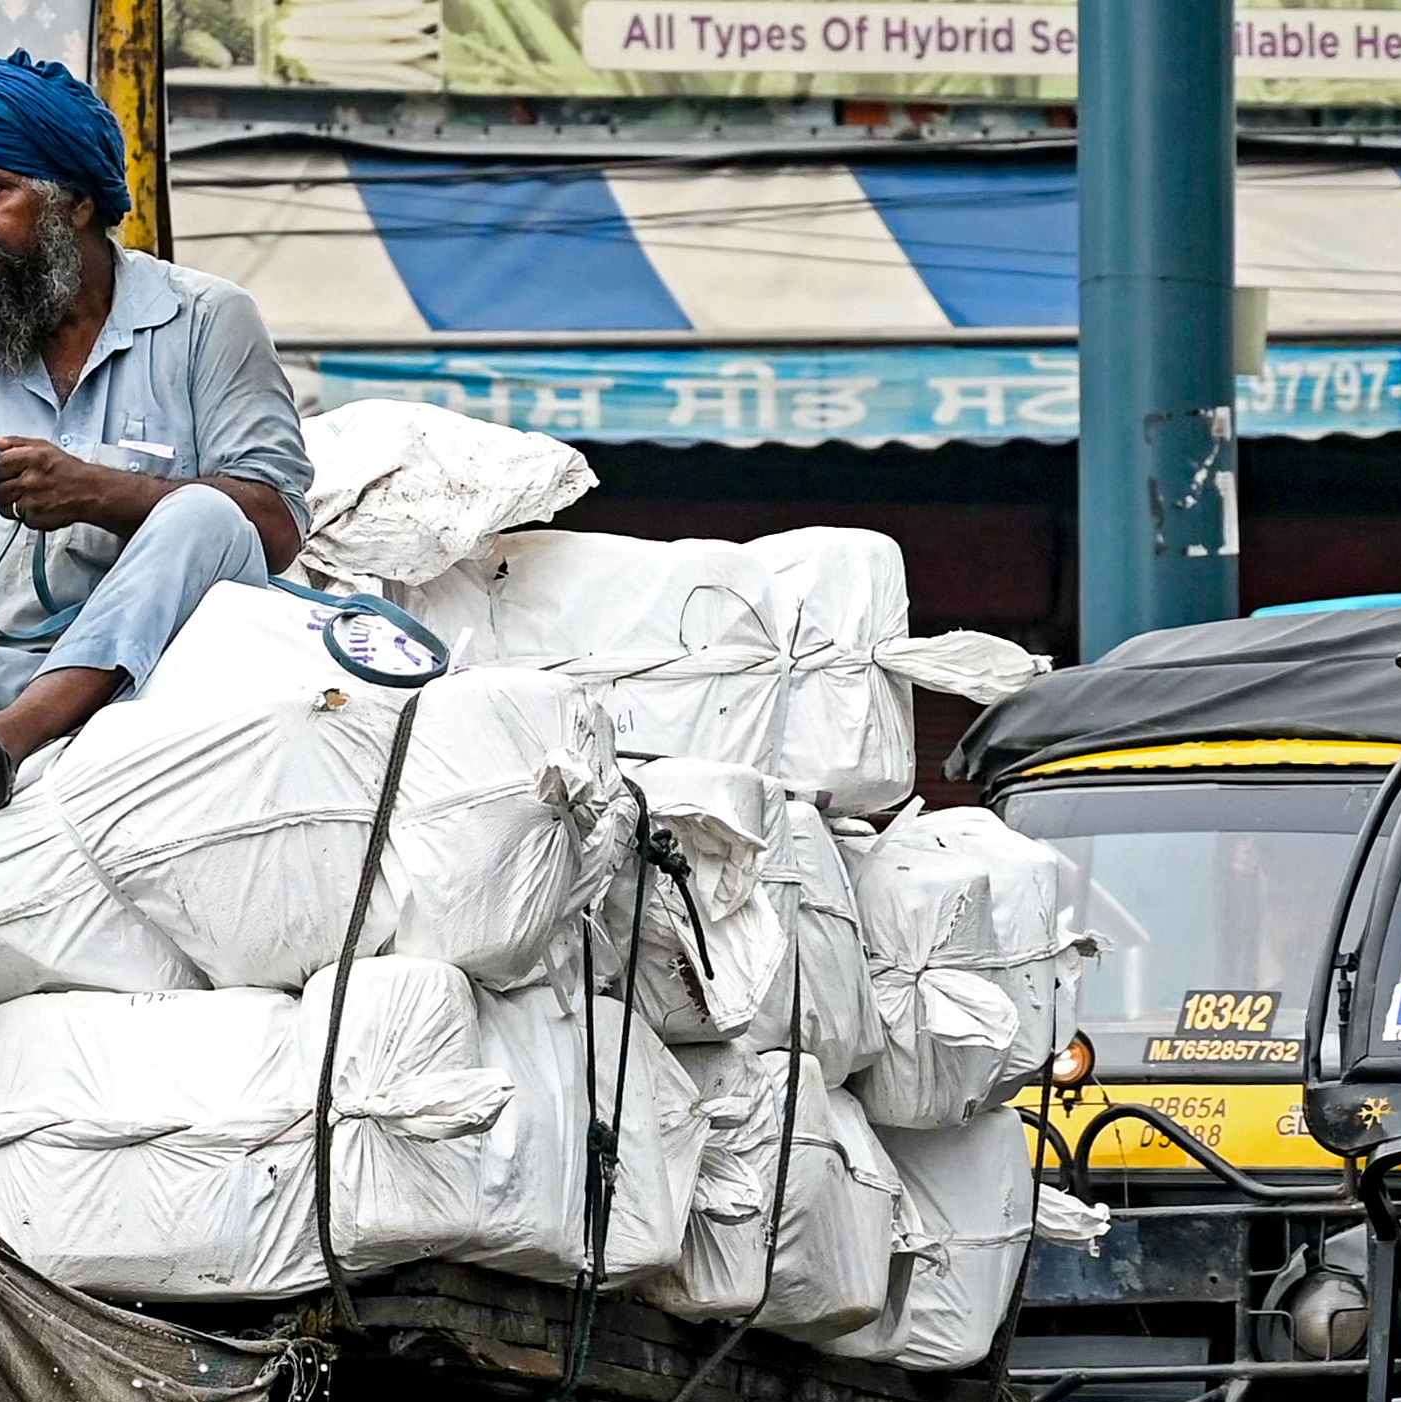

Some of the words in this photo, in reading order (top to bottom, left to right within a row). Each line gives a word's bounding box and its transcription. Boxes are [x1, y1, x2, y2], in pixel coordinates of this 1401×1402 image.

[622, 14, 674, 51] All
[690, 15, 807, 59] Types
[822, 15, 868, 53] Of
[883, 15, 1014, 60] Hybrid
[1235, 22, 1339, 59] ilable
[928, 352, 1080, 428] ਸਟੋ
[1183, 993, 1274, 1032] 18342
[1148, 1039, 1300, 1062] M.7652857732
[1139, 1122, 1222, 1149] D588
